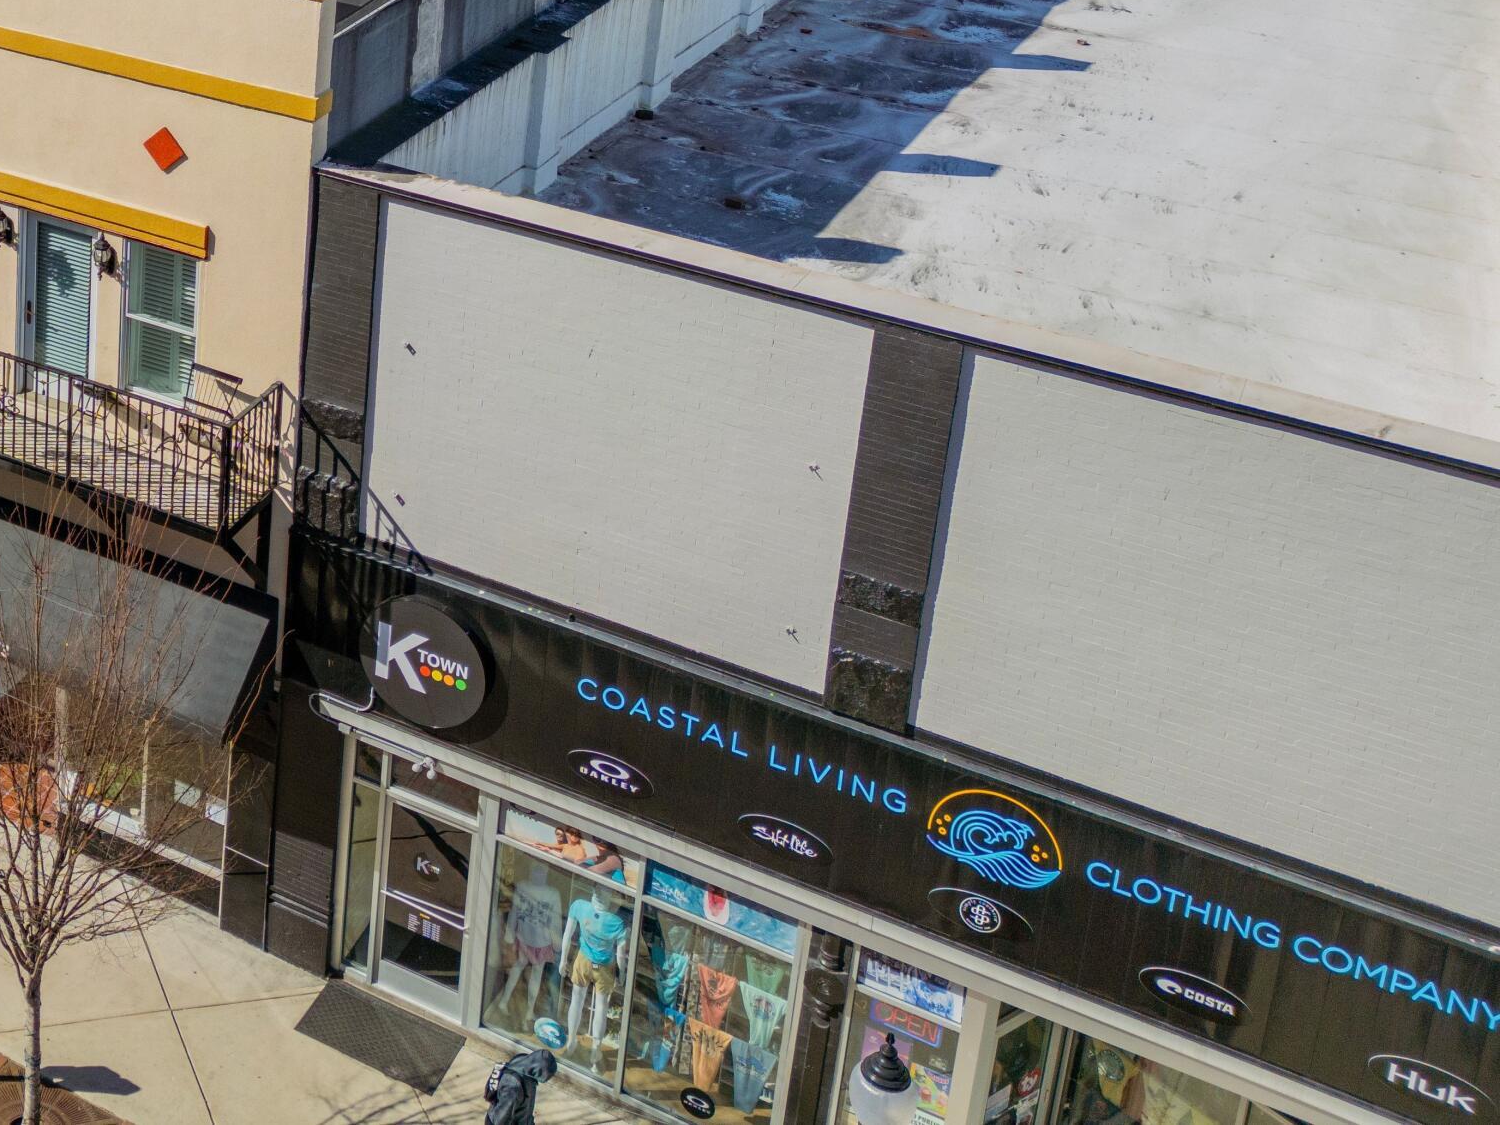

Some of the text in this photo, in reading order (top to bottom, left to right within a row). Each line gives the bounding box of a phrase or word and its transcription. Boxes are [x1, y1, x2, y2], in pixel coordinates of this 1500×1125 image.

[375, 621, 469, 695] K TOWN
[577, 678, 907, 814] COASTAL LIVING
[579, 765, 641, 794] OAKLEY
[1086, 861, 1500, 1031] CLOTHING COMPANY
[875, 1001, 938, 1044] OPEN
[1184, 986, 1236, 1017] COSTA
